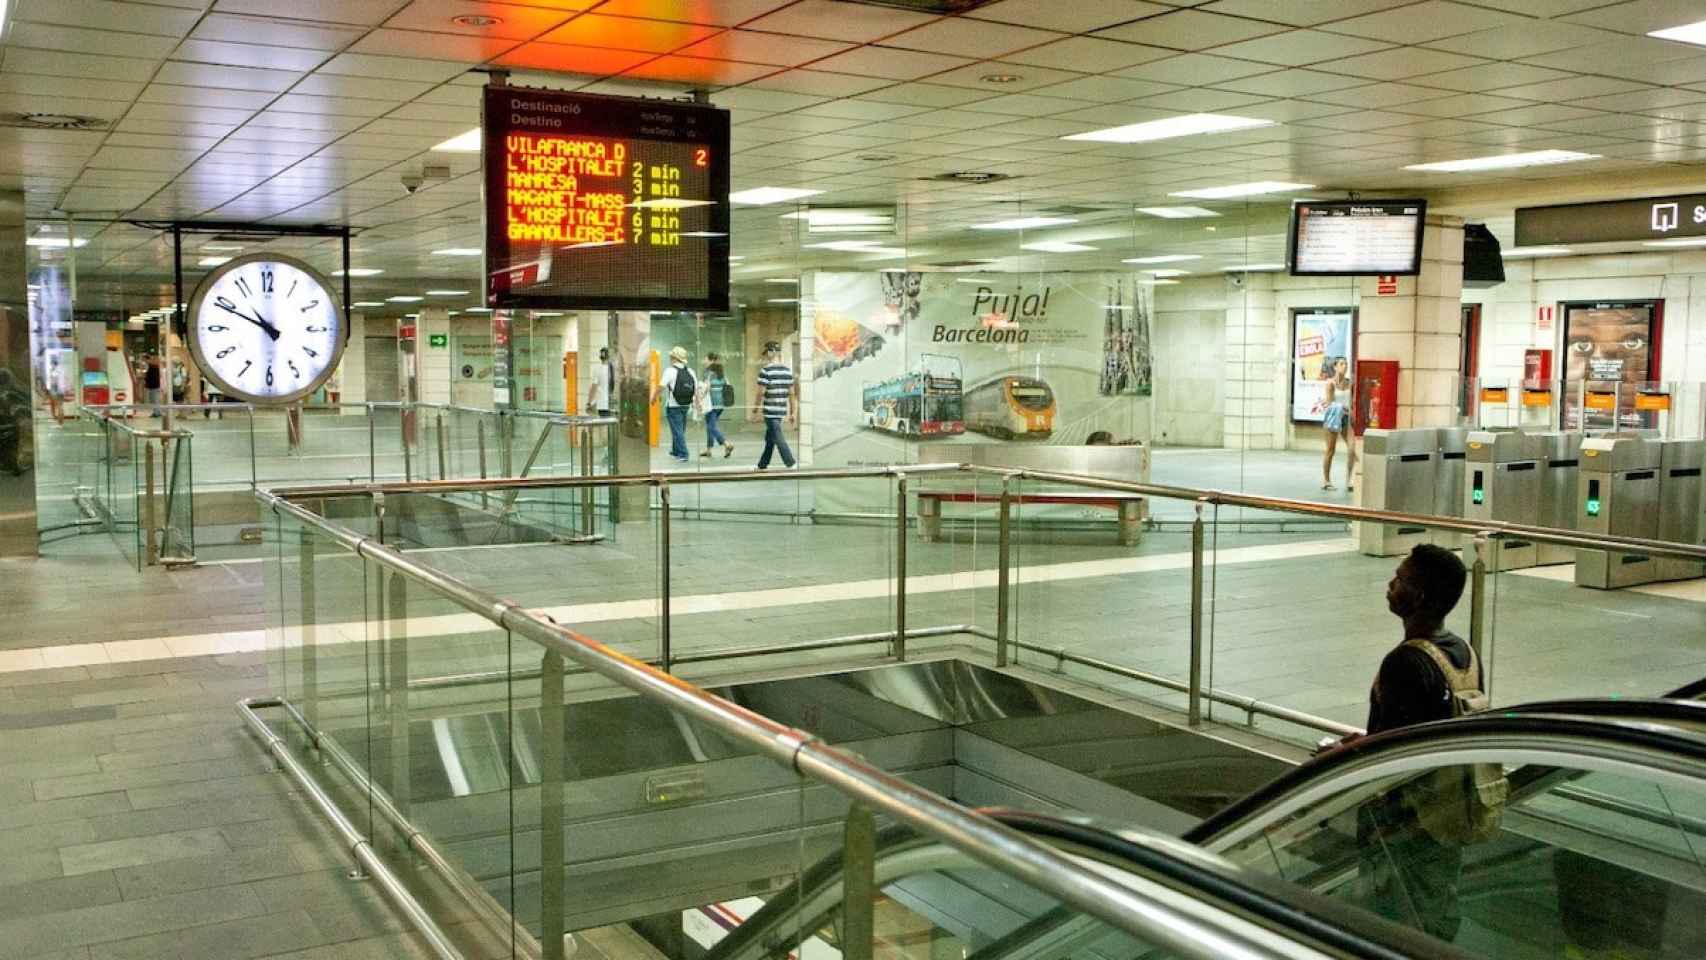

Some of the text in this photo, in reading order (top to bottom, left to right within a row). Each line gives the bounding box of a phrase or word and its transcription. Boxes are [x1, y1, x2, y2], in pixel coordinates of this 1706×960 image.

[511, 99, 581, 114] Destinació
[511, 113, 562, 128] Destino
[507, 136, 707, 166] VILAFRANCA D 2
[507, 153, 680, 180] L'HOSPITALET 2 min
[507, 171, 680, 197] MANRESA 3 min
[507, 205, 680, 230] L'HOSPITALET 6 min
[1693, 205, 1706, 223] S
[632, 228, 643, 244] 7
[651, 230, 680, 246] min
[234, 276, 253, 298] 11
[261, 271, 274, 293] 12
[286, 280, 297, 298] 1
[301, 300, 319, 313] 2
[972, 286, 1050, 323] Puja!
[208, 325, 230, 333] 9
[932, 325, 1029, 343] Barcelona
[216, 346, 236, 359] 8
[302, 346, 318, 358] 4
[238, 360, 252, 377] 7
[266, 365, 273, 386] 6
[287, 360, 300, 378] 5
